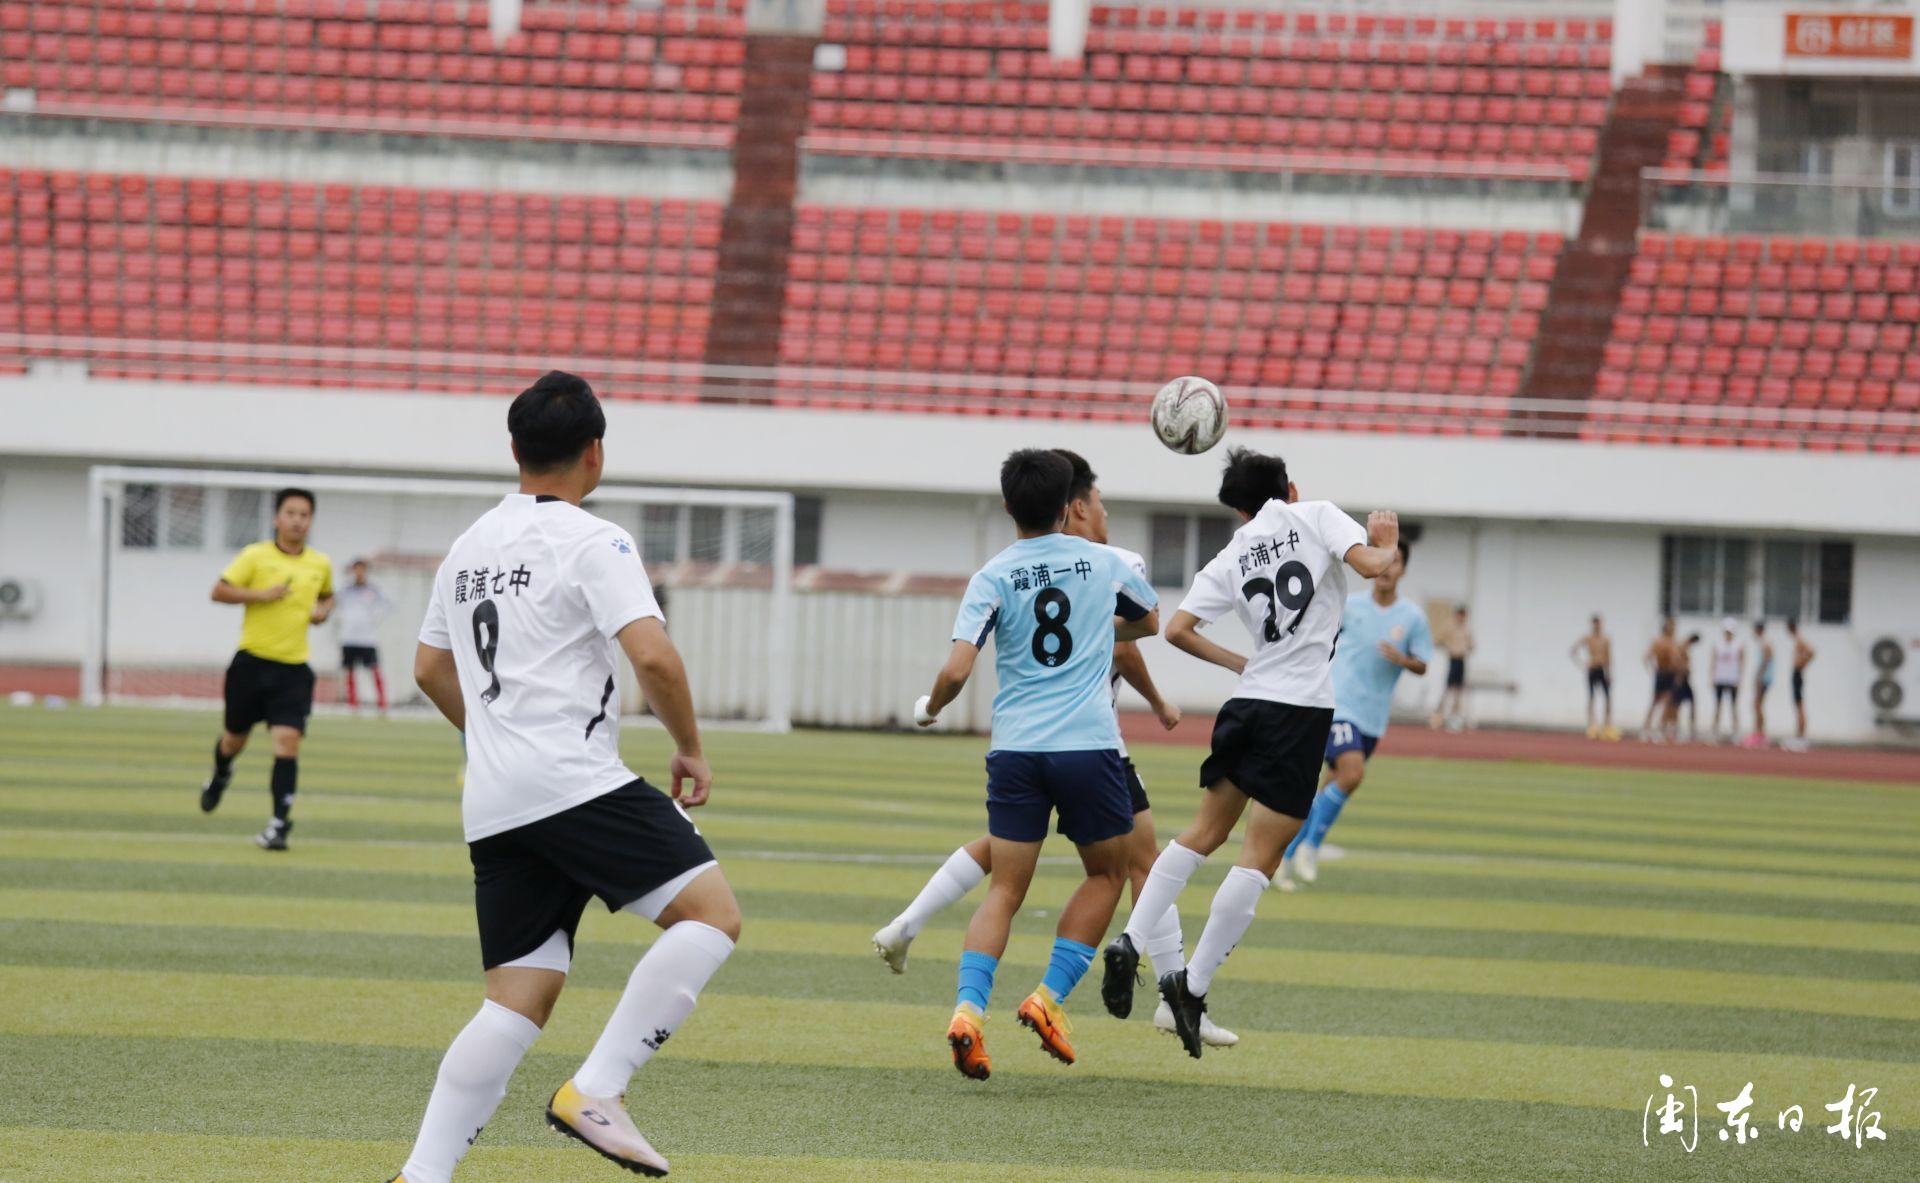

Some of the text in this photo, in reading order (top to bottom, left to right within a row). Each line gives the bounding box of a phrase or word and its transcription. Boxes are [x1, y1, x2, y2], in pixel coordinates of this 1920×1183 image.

[456, 564, 531, 604] 霞浦七中
[1011, 558, 1092, 592] 霞浦一中
[472, 599, 502, 704] 9
[1032, 587, 1073, 668] 8
